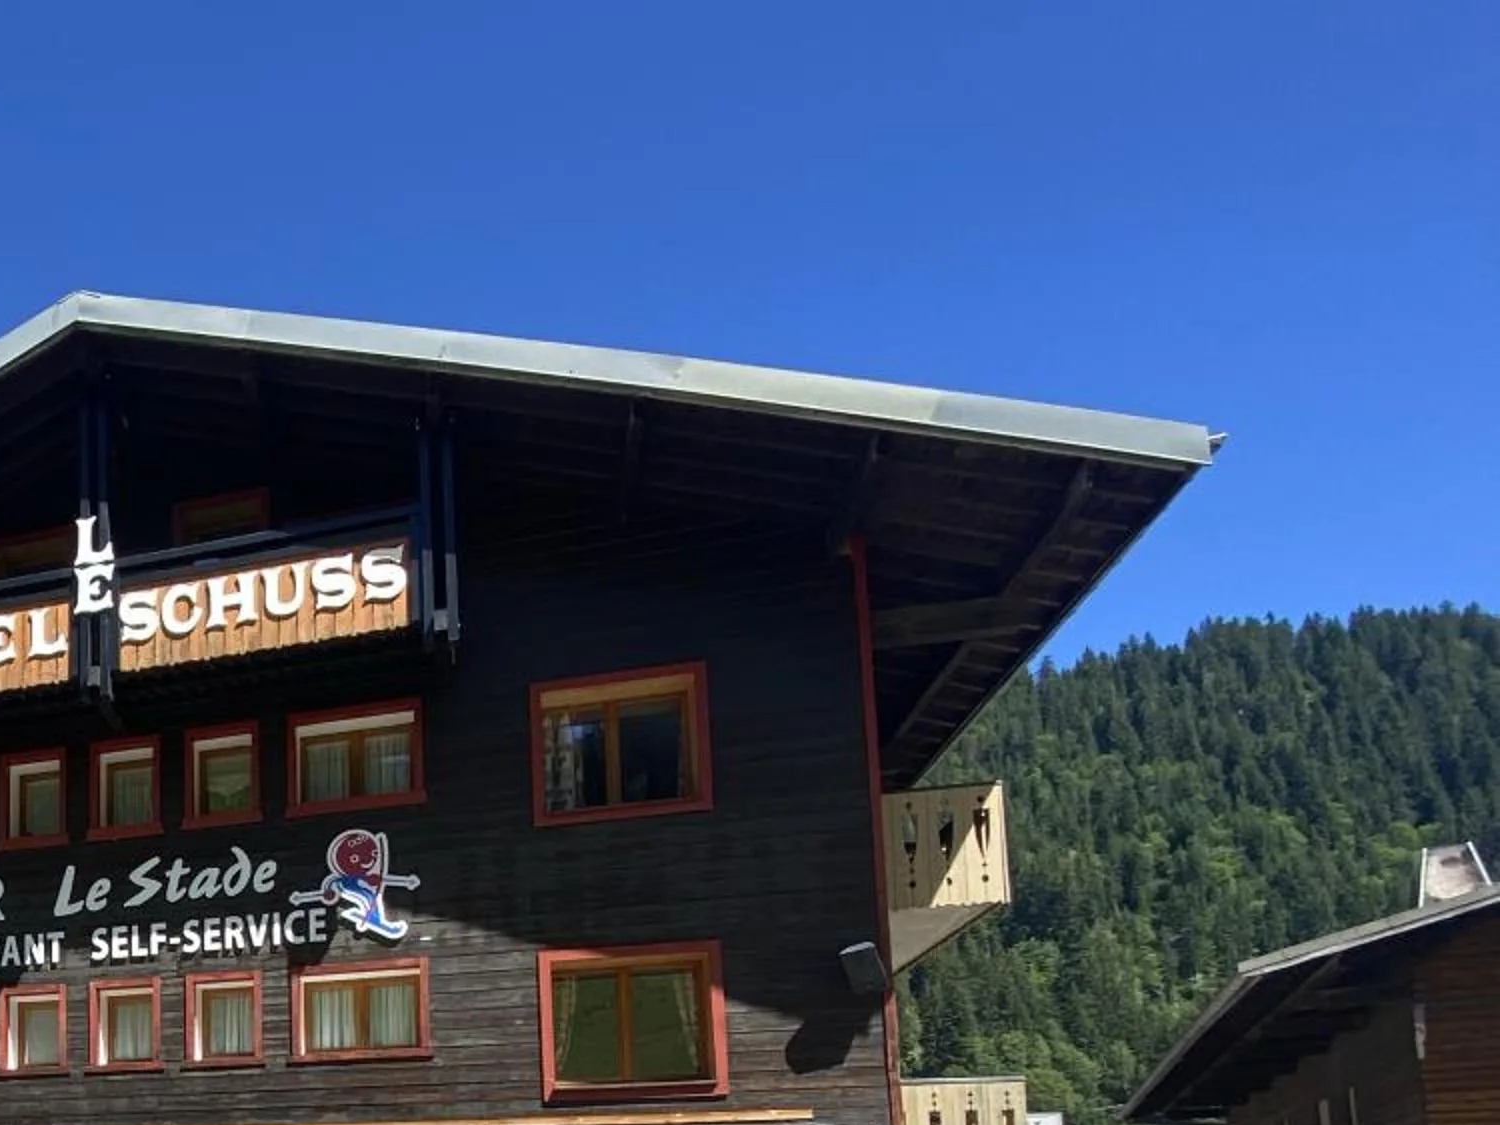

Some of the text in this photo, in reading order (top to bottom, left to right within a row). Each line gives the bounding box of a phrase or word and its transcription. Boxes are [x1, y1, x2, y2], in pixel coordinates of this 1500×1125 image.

[73, 515, 114, 614] LE
[117, 544, 408, 643] SCHUSS
[53, 864, 108, 918] Le
[123, 845, 278, 909] Stade
[89, 908, 328, 962] SELF-SERVICE
